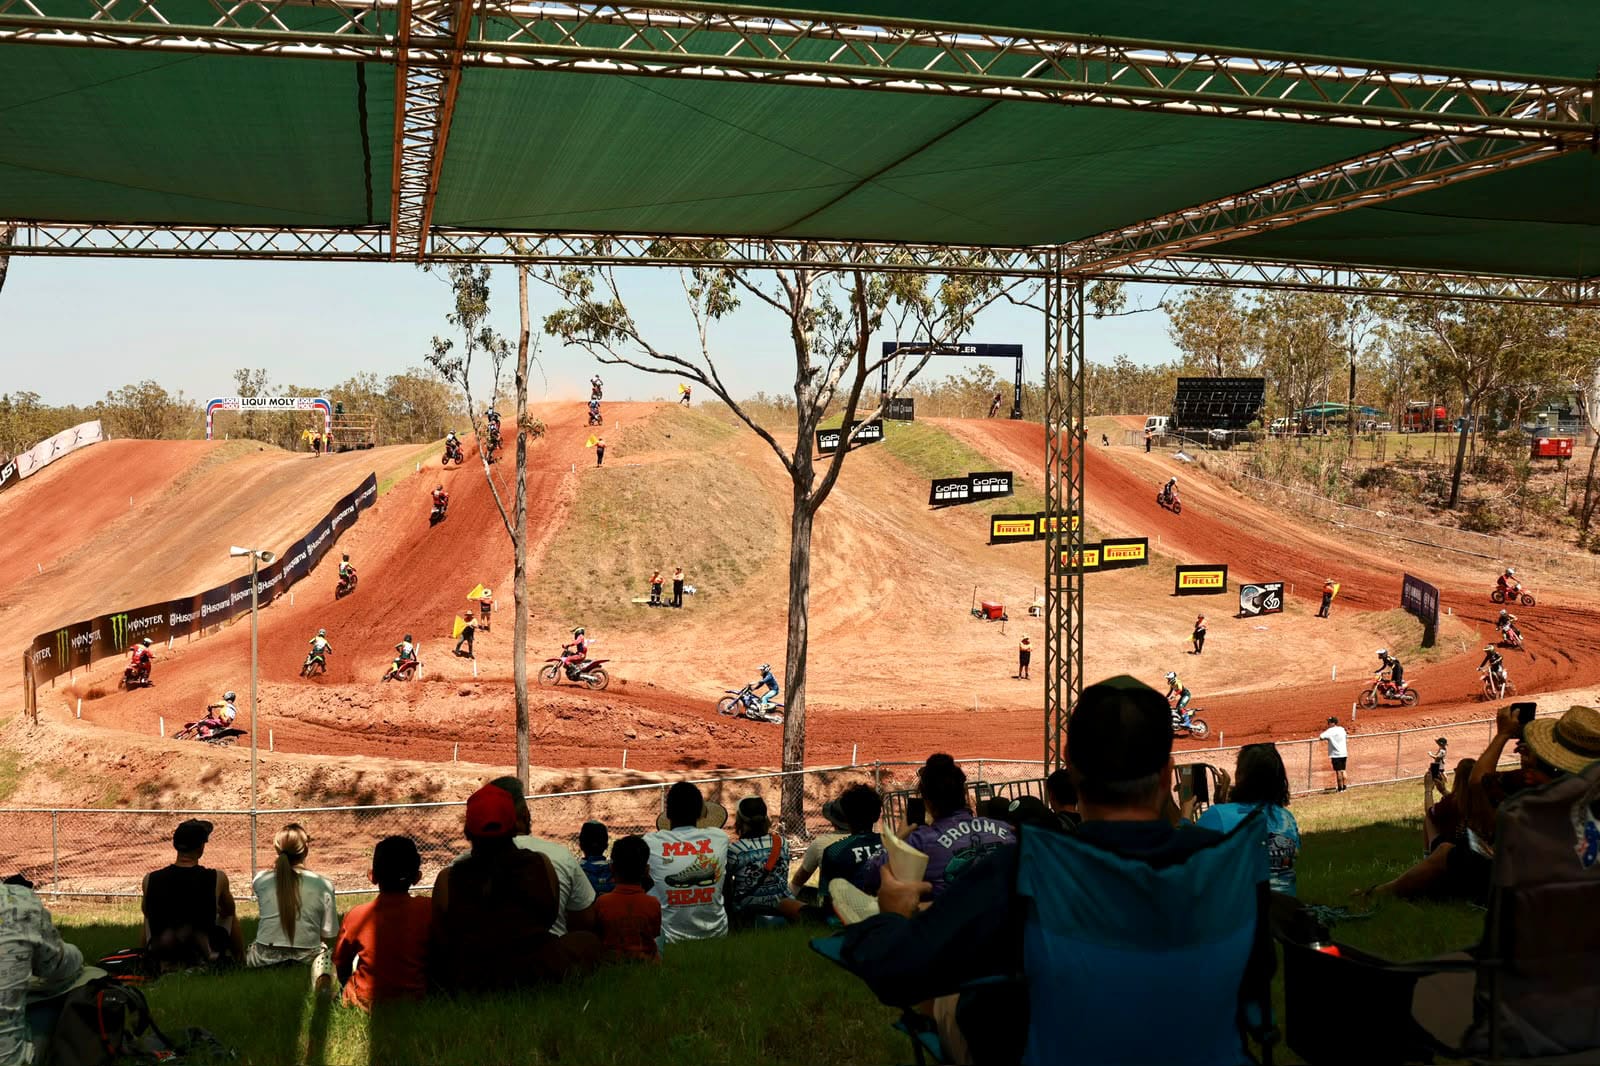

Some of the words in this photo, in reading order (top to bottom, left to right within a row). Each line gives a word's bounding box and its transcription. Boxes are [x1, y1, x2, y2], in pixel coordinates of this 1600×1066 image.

[242, 398, 266, 406] LIQUI
[269, 398, 295, 406] MOLY
[973, 477, 1009, 486] GoPro
[935, 484, 968, 493] GoPro
[997, 523, 1031, 533] PIRELLI
[1107, 546, 1142, 557] PIRELLI
[1183, 574, 1220, 585] PIRELLI
[206, 599, 230, 613] Husqvarna
[128, 614, 164, 632] MONSTER
[937, 818, 1008, 849] BROOME
[661, 838, 714, 857] MAX
[666, 887, 715, 905] HEAT
